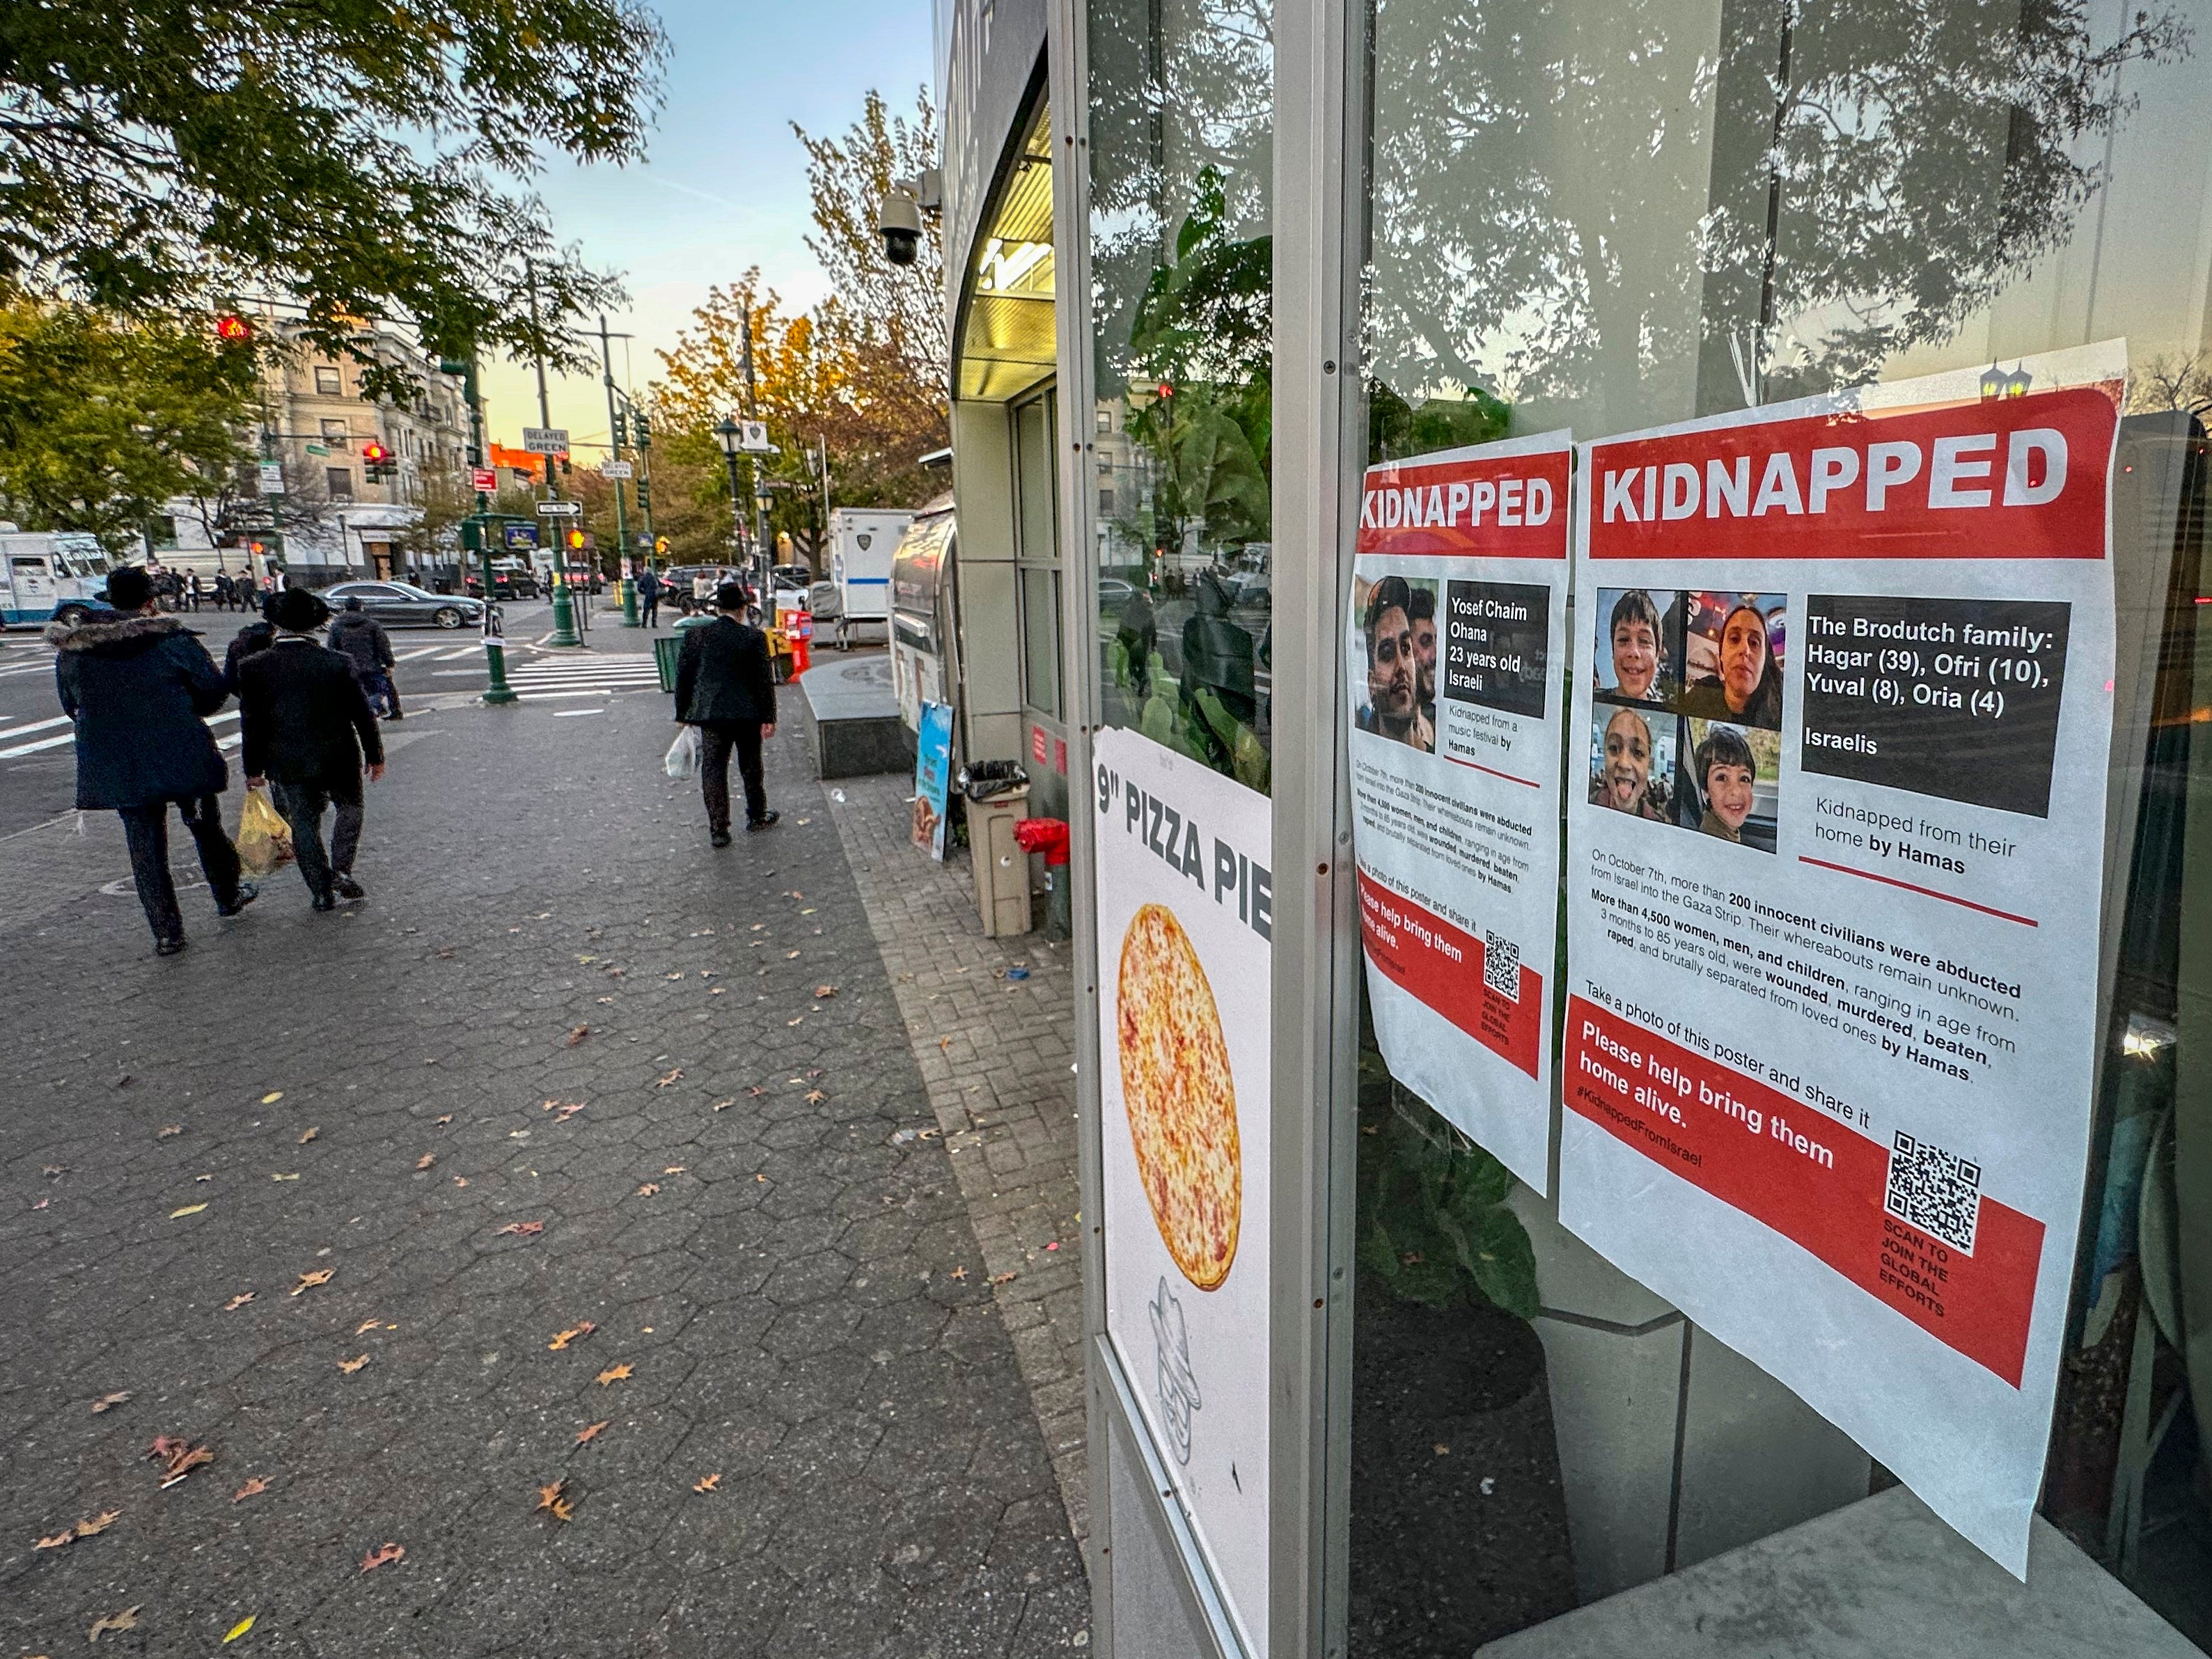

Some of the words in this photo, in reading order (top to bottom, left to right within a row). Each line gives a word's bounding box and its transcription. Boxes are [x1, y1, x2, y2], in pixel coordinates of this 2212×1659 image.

[528, 431, 565, 441] DELAYED
[528, 443, 566, 451] GREEN
[1601, 427, 2069, 524] KIDNAPPED
[1360, 478, 1553, 528] KIDNAPPED
[1452, 597, 1484, 615] Yosef
[1486, 600, 1527, 620] Chaim
[1450, 622, 1487, 642] Ohana
[1809, 616, 1846, 636] The
[1853, 618, 1955, 643] Brodutch
[1963, 624, 2053, 653] family:
[1450, 646, 1464, 662] 23
[1466, 652, 1496, 668] years
[1500, 654, 1521, 673] old
[1450, 669, 1482, 691] Israeli
[1808, 644, 1873, 670] Hagar
[1879, 648, 1926, 677] (39),
[1934, 653, 1980, 677] Ofri
[1989, 657, 2048, 689] (10),
[1807, 673, 1865, 697] Yuval
[1872, 678, 1905, 706] (8),
[1913, 684, 1963, 709] Oria
[1970, 689, 2005, 718] (4)
[1449, 724, 1471, 737] music
[1501, 735, 1511, 751] by
[1450, 705, 1490, 724] Kidnapped
[1492, 715, 1509, 730] from
[1512, 723, 1517, 732] a
[1805, 727, 1878, 755] Israelis
[1449, 739, 1475, 756] Hamas
[1480, 810, 1496, 822] were
[1497, 816, 1532, 835] abducted
[1817, 797, 1913, 833] Kidnapped
[1920, 820, 1961, 845] from
[1969, 832, 2017, 858] their
[1097, 763, 1120, 814] 9"
[1126, 780, 1206, 892] PIZZA
[1214, 837, 1271, 943] PIE
[1426, 821, 1437, 831] and
[1498, 852, 1511, 865] age
[1513, 856, 1529, 872] from
[1815, 822, 1863, 847] home
[1869, 835, 1892, 858] by
[1899, 841, 1966, 874] Hamas
[1478, 870, 1487, 883] by
[1388, 876, 1394, 887] of
[1396, 879, 1409, 894] this
[1411, 888, 1431, 905] poster
[1433, 901, 1446, 915] and
[1449, 909, 1469, 928] share
[1472, 918, 1476, 932] it
[1592, 849, 1606, 863] On
[1608, 854, 1645, 876] October
[1649, 867, 1667, 885] 7th,
[1671, 876, 1699, 893] more
[1703, 883, 1725, 902] than
[1729, 893, 1751, 910] 200
[1755, 900, 1816, 931] innocent
[1820, 922, 1885, 952] civilians
[1890, 944, 1931, 966] were
[1936, 959, 2021, 999] abducted
[1376, 925, 1399, 950] alive.
[1381, 902, 1401, 928] help
[1404, 914, 1431, 948] bring
[1434, 933, 1461, 964] them
[1591, 865, 1611, 881] from
[1614, 872, 1638, 891] Israel
[1641, 883, 1658, 898] into
[1662, 890, 1679, 904] the
[1683, 895, 1712, 915] Gaza
[1716, 906, 1744, 927] Strip.
[1749, 917, 1779, 938] Their
[1784, 931, 1874, 970] whereabouts
[1878, 963, 1932, 991] remain
[1938, 982, 2019, 1022] unknown.
[1591, 888, 1615, 906] More
[1618, 898, 1638, 915] than
[1641, 908, 1670, 927] 4,500
[1674, 920, 1719, 945] women,
[1723, 938, 1753, 959] men,
[1758, 949, 1783, 966] and
[1787, 960, 1849, 994] children,
[1855, 984, 1911, 1019] ranging
[1917, 1004, 1931, 1022] in
[1937, 1014, 1970, 1036] age
[1977, 1026, 2015, 1054] from
[1601, 909, 1607, 920] 3
[1609, 913, 1642, 934] months
[1644, 926, 1654, 939] to
[1657, 930, 1670, 945] 85
[1674, 938, 1705, 957] years
[1708, 950, 1729, 967] old,
[1732, 959, 1762, 977] were
[1765, 970, 1831, 1007] wounded,
[1837, 997, 1917, 1041] murdered,
[1924, 1030, 1992, 1069] beaten,
[1607, 929, 1636, 948] raped,
[1640, 943, 1658, 958] and
[1662, 949, 1703, 976] brutally
[1707, 966, 1766, 999] separated
[1770, 989, 1798, 1013] from
[1802, 1003, 1838, 1029] loved
[1843, 1021, 1876, 1045] ones
[1882, 1035, 1901, 1057] by
[1906, 1045, 1973, 1083] Hamas.
[1586, 980, 1612, 1005] Take
[1615, 997, 1622, 1010] a
[1626, 1003, 1663, 1029] photo
[1668, 1022, 1681, 1038] of
[1684, 1027, 1710, 1051] this
[1713, 1043, 1765, 1076] poster
[1769, 1067, 1801, 1093] and
[1806, 1084, 1853, 1121] share
[1859, 1108, 1870, 1130] it
[1580, 1051, 1629, 1095] home
[1634, 1086, 1687, 1129] alive.
[1582, 1020, 1642, 1069] Please
[1648, 1053, 1692, 1099] help
[1699, 1080, 1762, 1134] bring
[1771, 1115, 1835, 1170] them
[1576, 1086, 1702, 1168] #KidnappedFromIsrael
[1882, 1237, 1915, 1261] JOIN
[1918, 1257, 1948, 1282] THE
[1884, 1219, 1924, 1250] SCAN
[1929, 1243, 1948, 1263] TO
[1879, 1268, 1945, 1316] EFFORTS
[1881, 1253, 1939, 1296] GLOBAL
